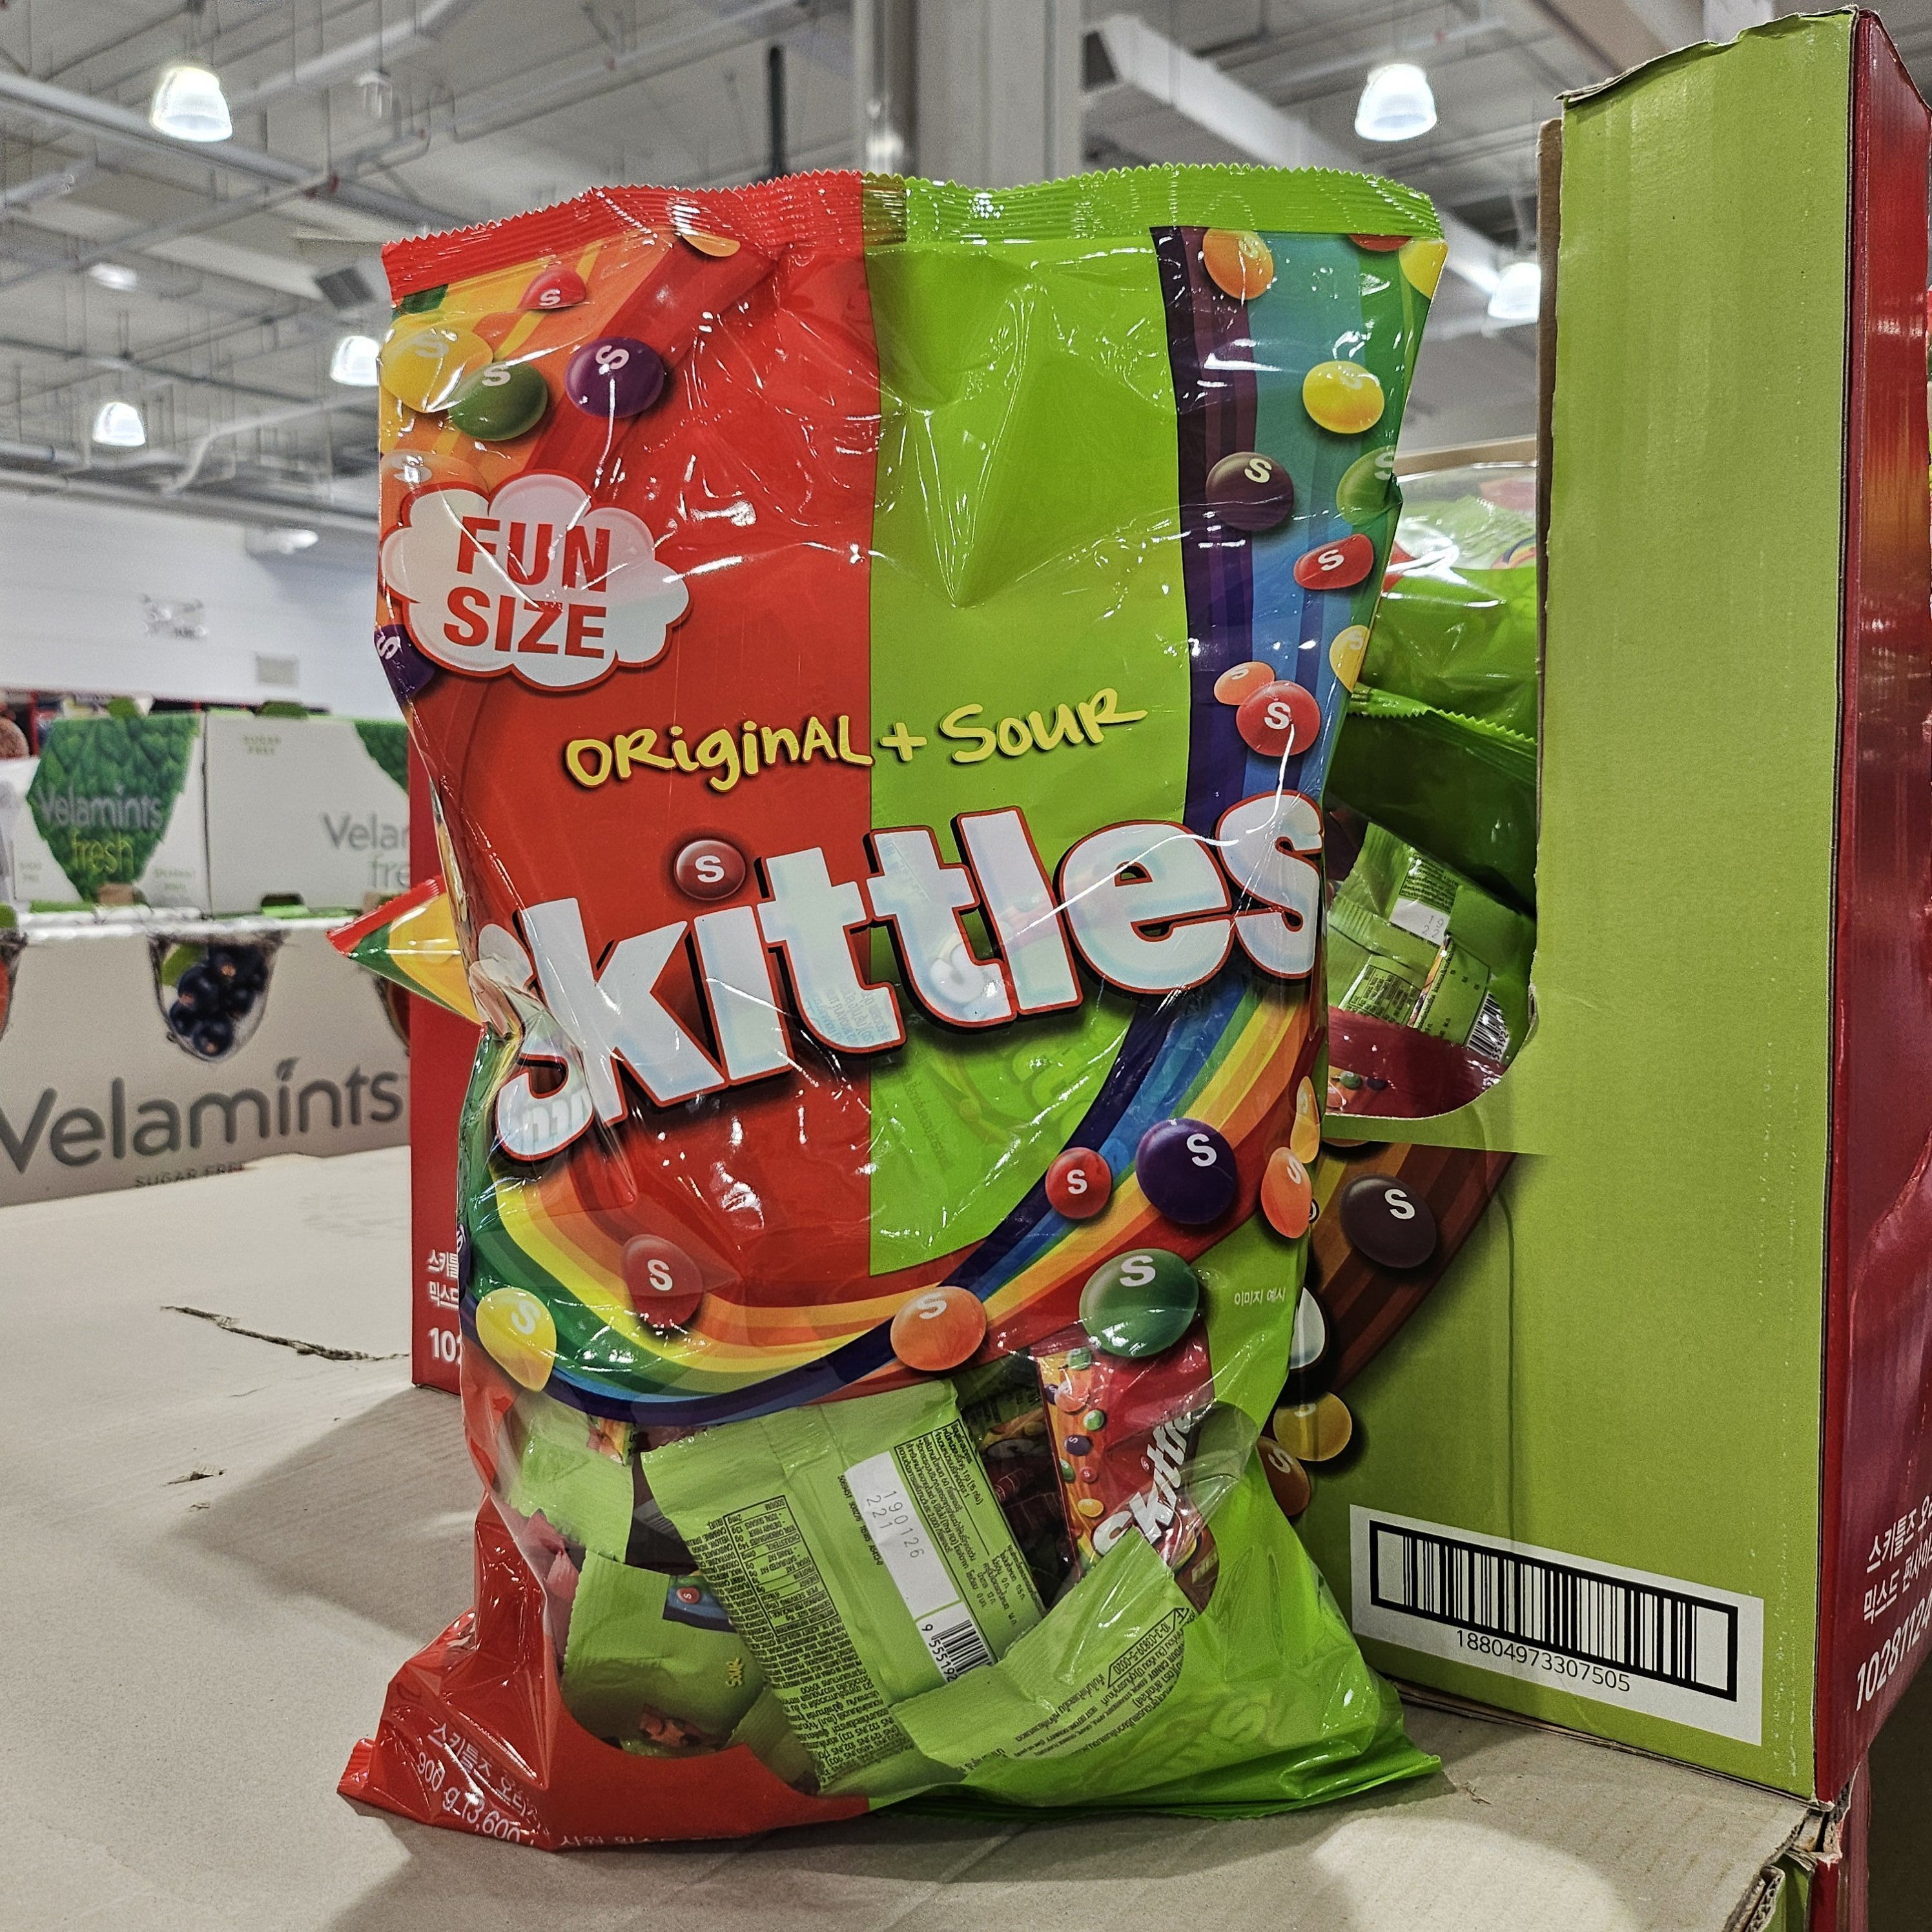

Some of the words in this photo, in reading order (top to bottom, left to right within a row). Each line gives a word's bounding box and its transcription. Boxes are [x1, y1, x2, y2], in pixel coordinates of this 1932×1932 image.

[456, 517, 610, 591] FUN
[443, 586, 604, 659] SIZE
[36, 783, 161, 829] Velamints
[68, 827, 134, 874] fresh
[0, 1057, 404, 1173] Velamints
[1234, 1290, 1263, 1306] 이미지
[1267, 1287, 1286, 1302] 예시
[731, 1526, 743, 1534] 13g
[867, 1495, 892, 1528] 221
[885, 1491, 924, 1557] 190126
[737, 1541, 749, 1550] 14g
[768, 1554, 777, 1562] FAT
[1866, 1508, 1917, 1574] 스키틀즈
[760, 1566, 769, 1574] FAT
[786, 1564, 795, 1573] FAT
[1864, 1568, 1900, 1625] 믹스드
[1113, 1623, 1170, 1674] 10-3-03839-5-0020
[1148, 1660, 1169, 1680] CANDY
[1455, 1629, 1632, 1693] 18804973307505
[417, 1751, 446, 1791] 900
